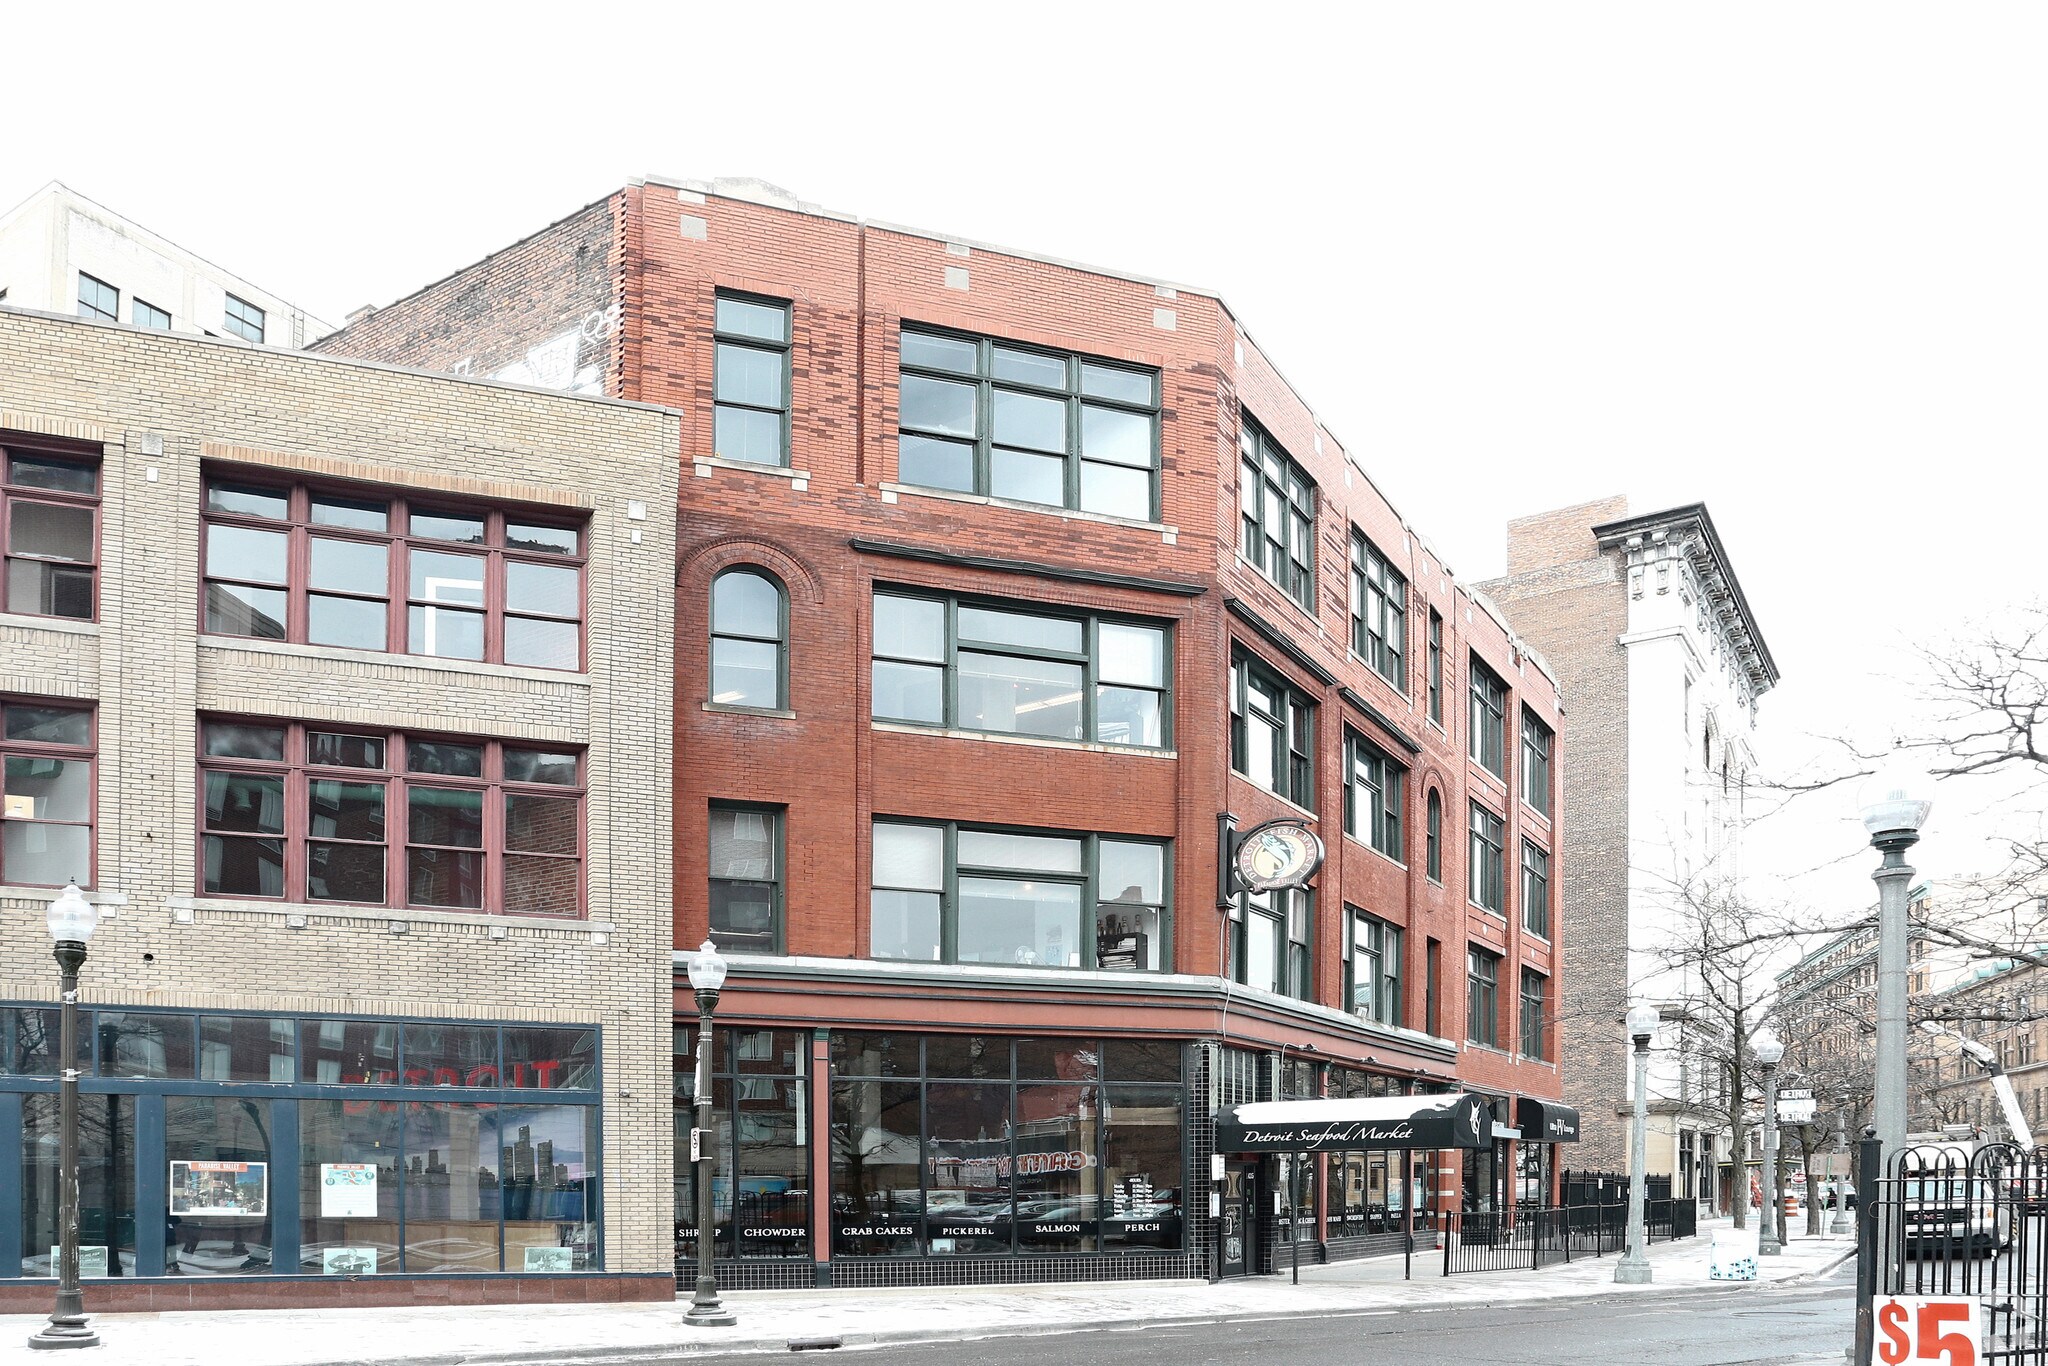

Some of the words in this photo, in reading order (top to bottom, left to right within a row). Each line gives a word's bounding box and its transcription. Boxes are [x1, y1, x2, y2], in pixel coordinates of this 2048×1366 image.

[1242, 836, 1262, 879] DETROIT
[1270, 827, 1298, 836] FISH
[1299, 834, 1316, 875] MARKET
[342, 1060, 560, 1114] DETROIT
[1242, 1130, 1294, 1143] Detroit
[1296, 1122, 1360, 1149] Seafood
[1352, 1122, 1414, 1141] Market
[223, 1163, 240, 1171] VALLEY
[842, 1227, 873, 1236] CRAB
[875, 1226, 913, 1235] CAKES
[942, 1227, 995, 1235] PICKEREL
[1035, 1224, 1081, 1233] SALMON
[1124, 1223, 1160, 1232] PERCH
[678, 1228, 722, 1237] SHRP
[743, 1228, 806, 1237] CHOWDER
[1879, 1299, 1975, 1366] $5
